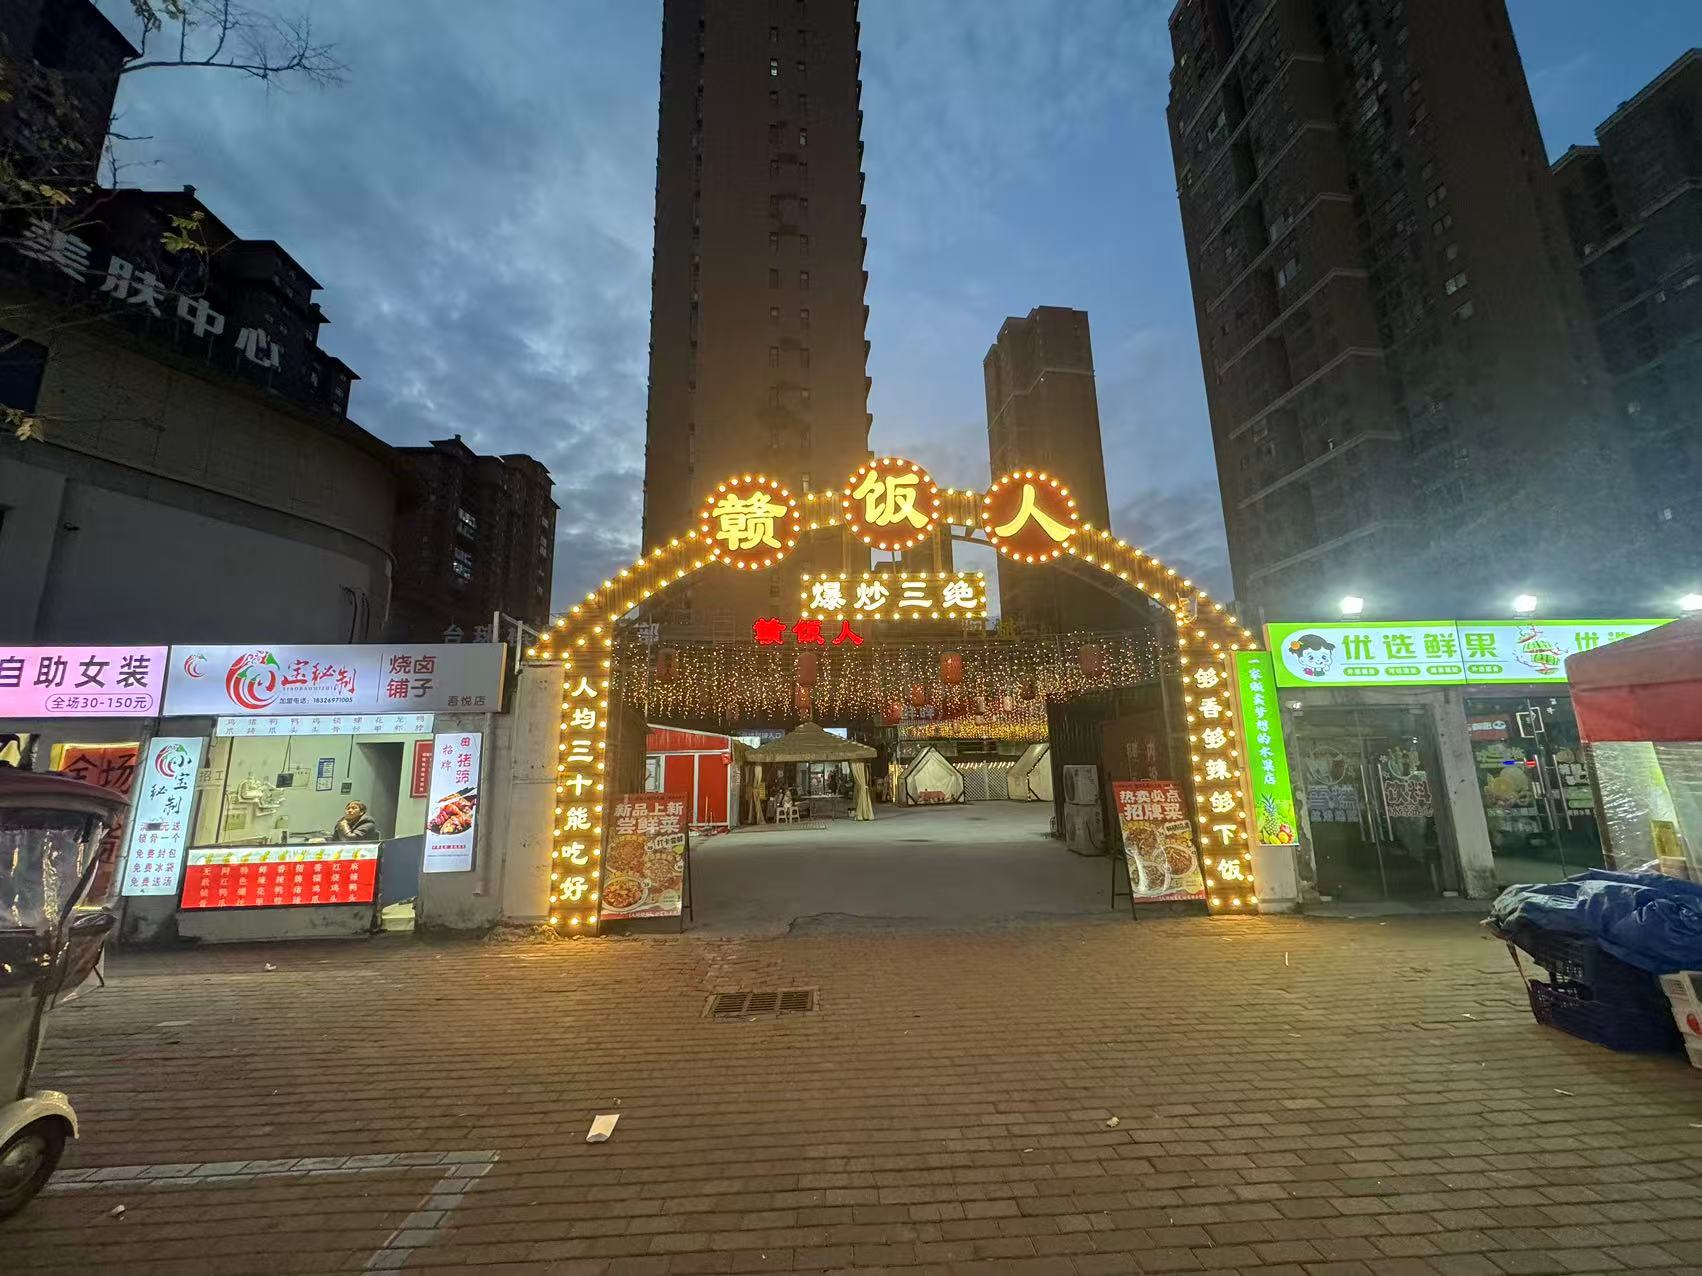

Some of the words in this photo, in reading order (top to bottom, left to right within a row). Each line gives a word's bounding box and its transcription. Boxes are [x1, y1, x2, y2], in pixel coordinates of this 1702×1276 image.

[713, 469, 1073, 551] 赣饭人
[810, 580, 978, 611] 爆炒三绝
[1341, 633, 1499, 661] 优选鲜果
[1574, 632, 1633, 651] 优
[0, 655, 151, 689] 自助女装
[388, 654, 437, 674] 烧卤
[386, 678, 433, 699] 铺子
[51, 696, 147, 709] 全场30-150元
[447, 695, 487, 707] 吾悦店
[440, 744, 453, 772] 招牌
[456, 753, 471, 784] 猪蹄
[60, 752, 136, 795] 全场
[199, 770, 224, 782] 招工
[1193, 667, 1244, 881] 够香够辣够下饭
[560, 676, 598, 901] 人均三十能吃好
[1119, 790, 1182, 803] 热卖必点
[613, 802, 684, 817] 新品上新
[1124, 803, 1183, 821] 招牌菜
[616, 815, 680, 834] 尝鲜菜
